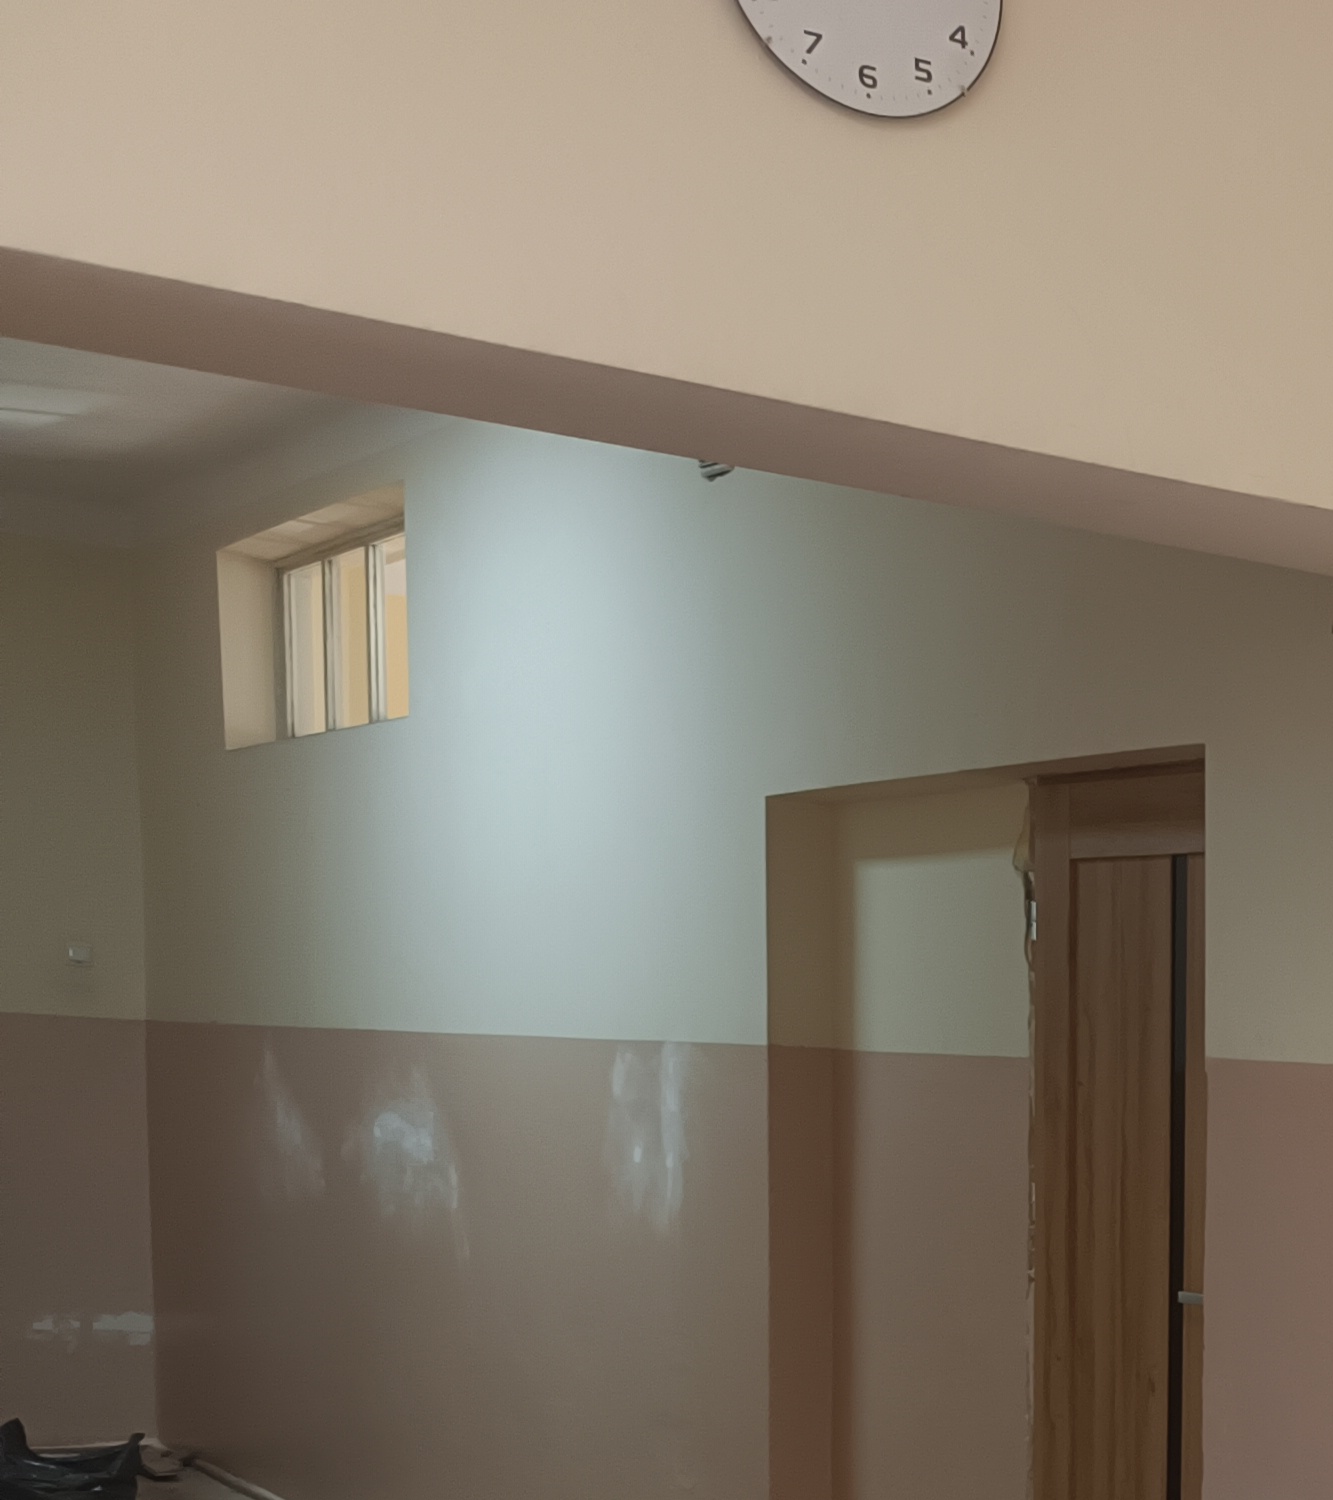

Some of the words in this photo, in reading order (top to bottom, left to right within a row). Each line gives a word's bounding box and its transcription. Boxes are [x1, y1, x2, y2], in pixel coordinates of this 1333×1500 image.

[803, 29, 823, 55] 7
[948, 25, 969, 50] 4
[857, 64, 878, 89] 6
[914, 57, 933, 83] 5
